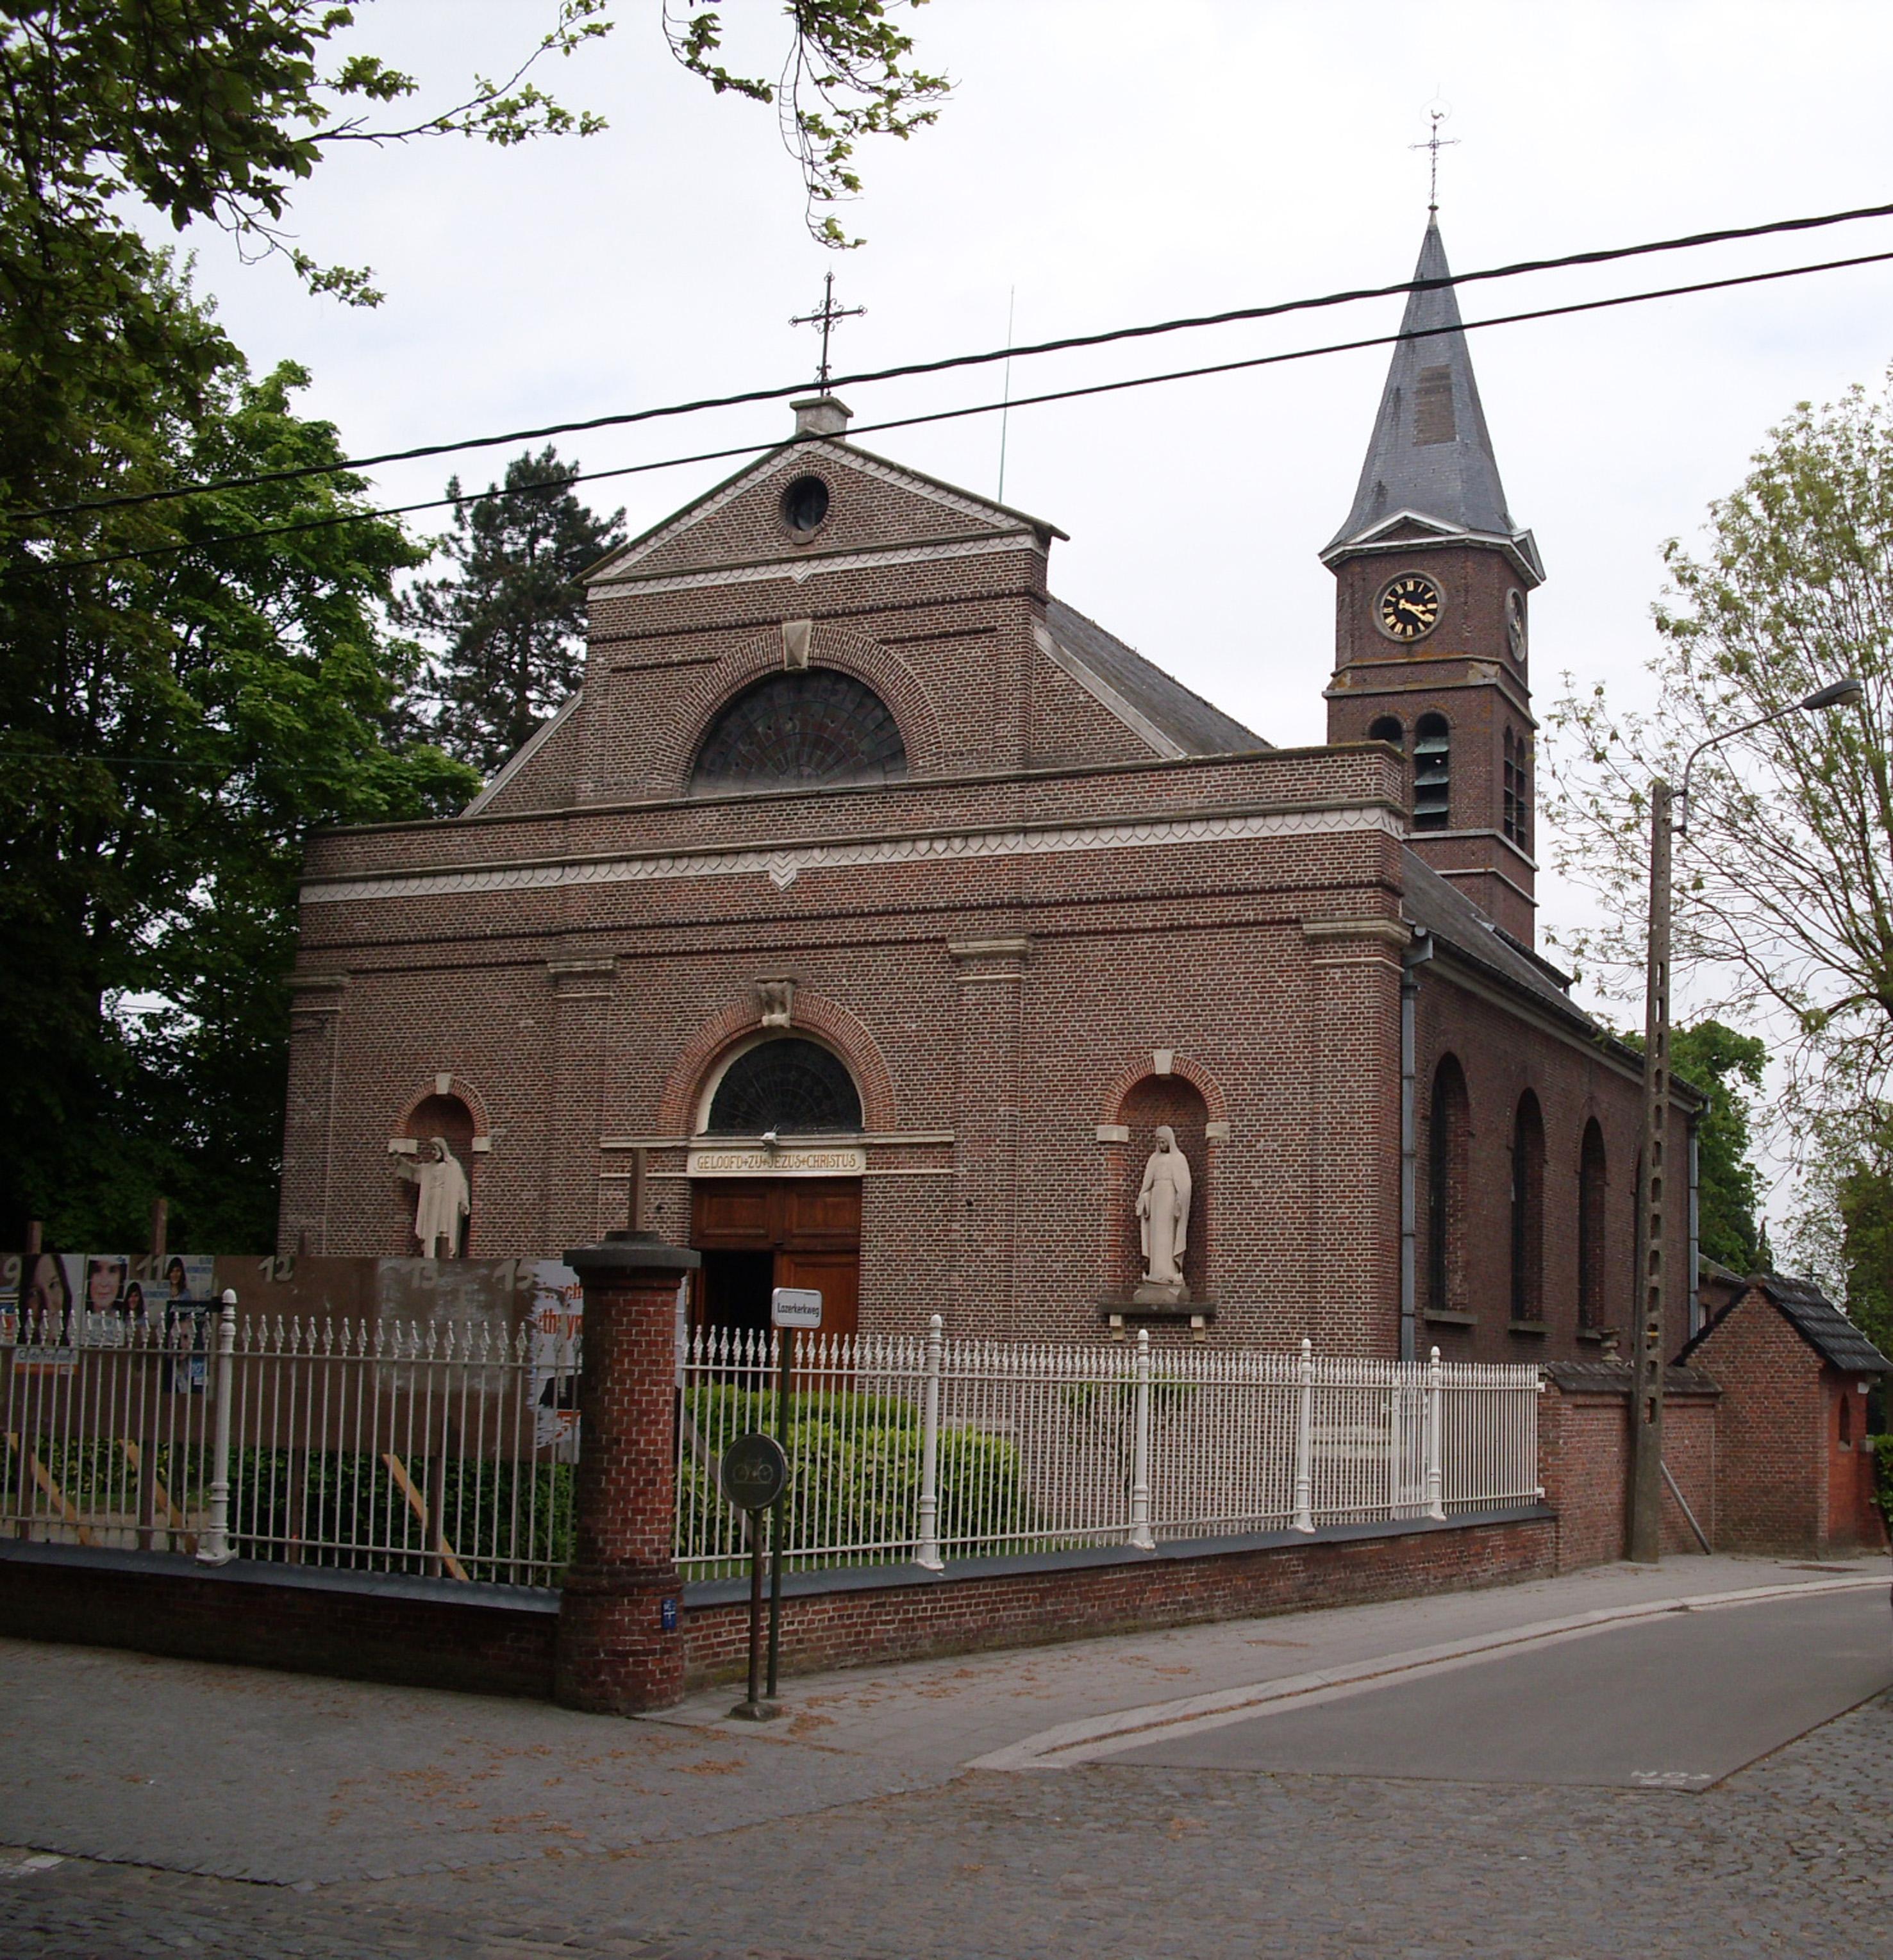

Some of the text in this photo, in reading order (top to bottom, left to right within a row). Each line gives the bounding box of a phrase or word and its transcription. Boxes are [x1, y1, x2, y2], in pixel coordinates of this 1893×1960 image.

[697, 1155, 742, 1169] GELOOFD
[768, 1155, 801, 1168] JEZUS
[806, 1154, 855, 1168] CHRISTUS
[3, 1255, 21, 1286] 9
[136, 1253, 165, 1280] 11
[257, 1255, 295, 1282] 12
[399, 1260, 438, 1289] 13
[492, 1259, 538, 1291] 15
